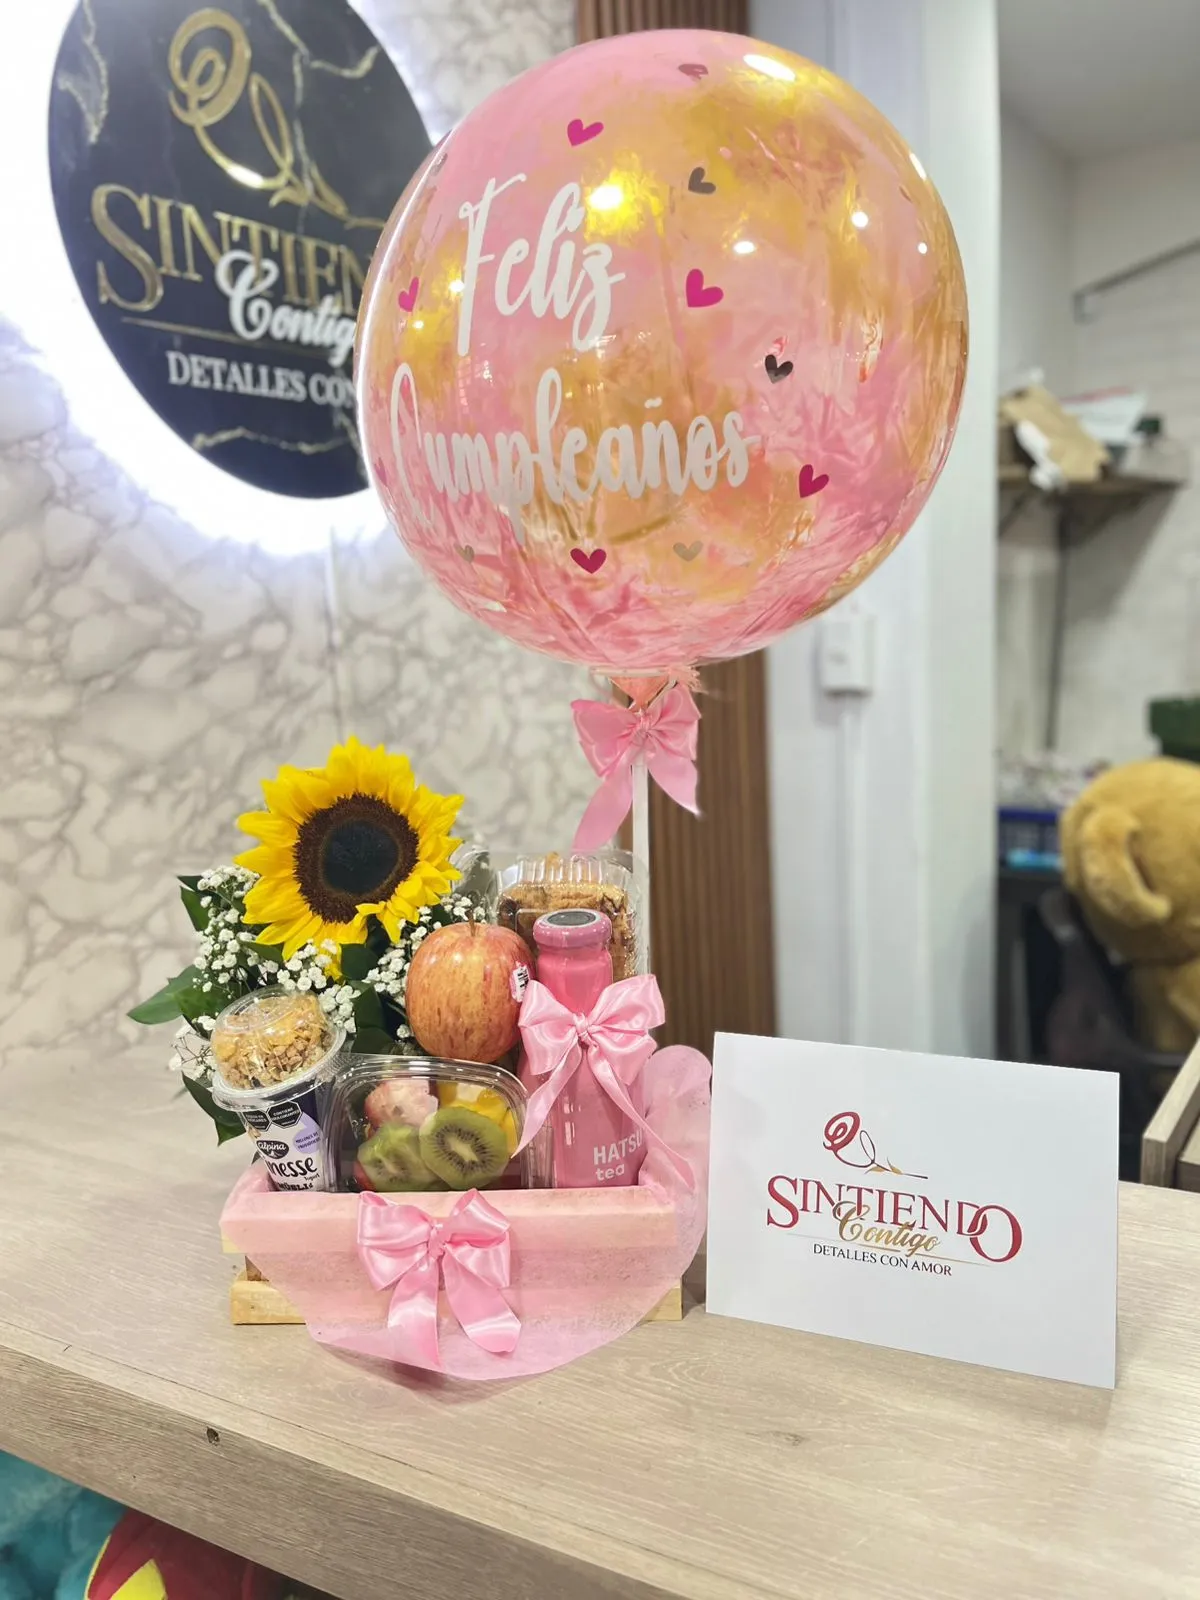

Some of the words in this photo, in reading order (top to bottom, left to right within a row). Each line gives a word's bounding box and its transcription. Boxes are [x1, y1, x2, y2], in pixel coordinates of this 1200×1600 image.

[91, 183, 366, 316] SINTIEN
[457, 172, 626, 357] Feliz
[215, 250, 357, 367] Contig
[166, 350, 307, 402] DETALLES
[390, 362, 761, 546] Cumpleaños
[257, 1141, 287, 1152] alpina
[596, 1163, 625, 1182] tea
[767, 1175, 1023, 1263] SINTIENDO
[833, 1200, 941, 1258] Contigo
[812, 1242, 877, 1265] DETALLES
[880, 1255, 909, 1271] CON
[911, 1260, 952, 1277] AMOR
